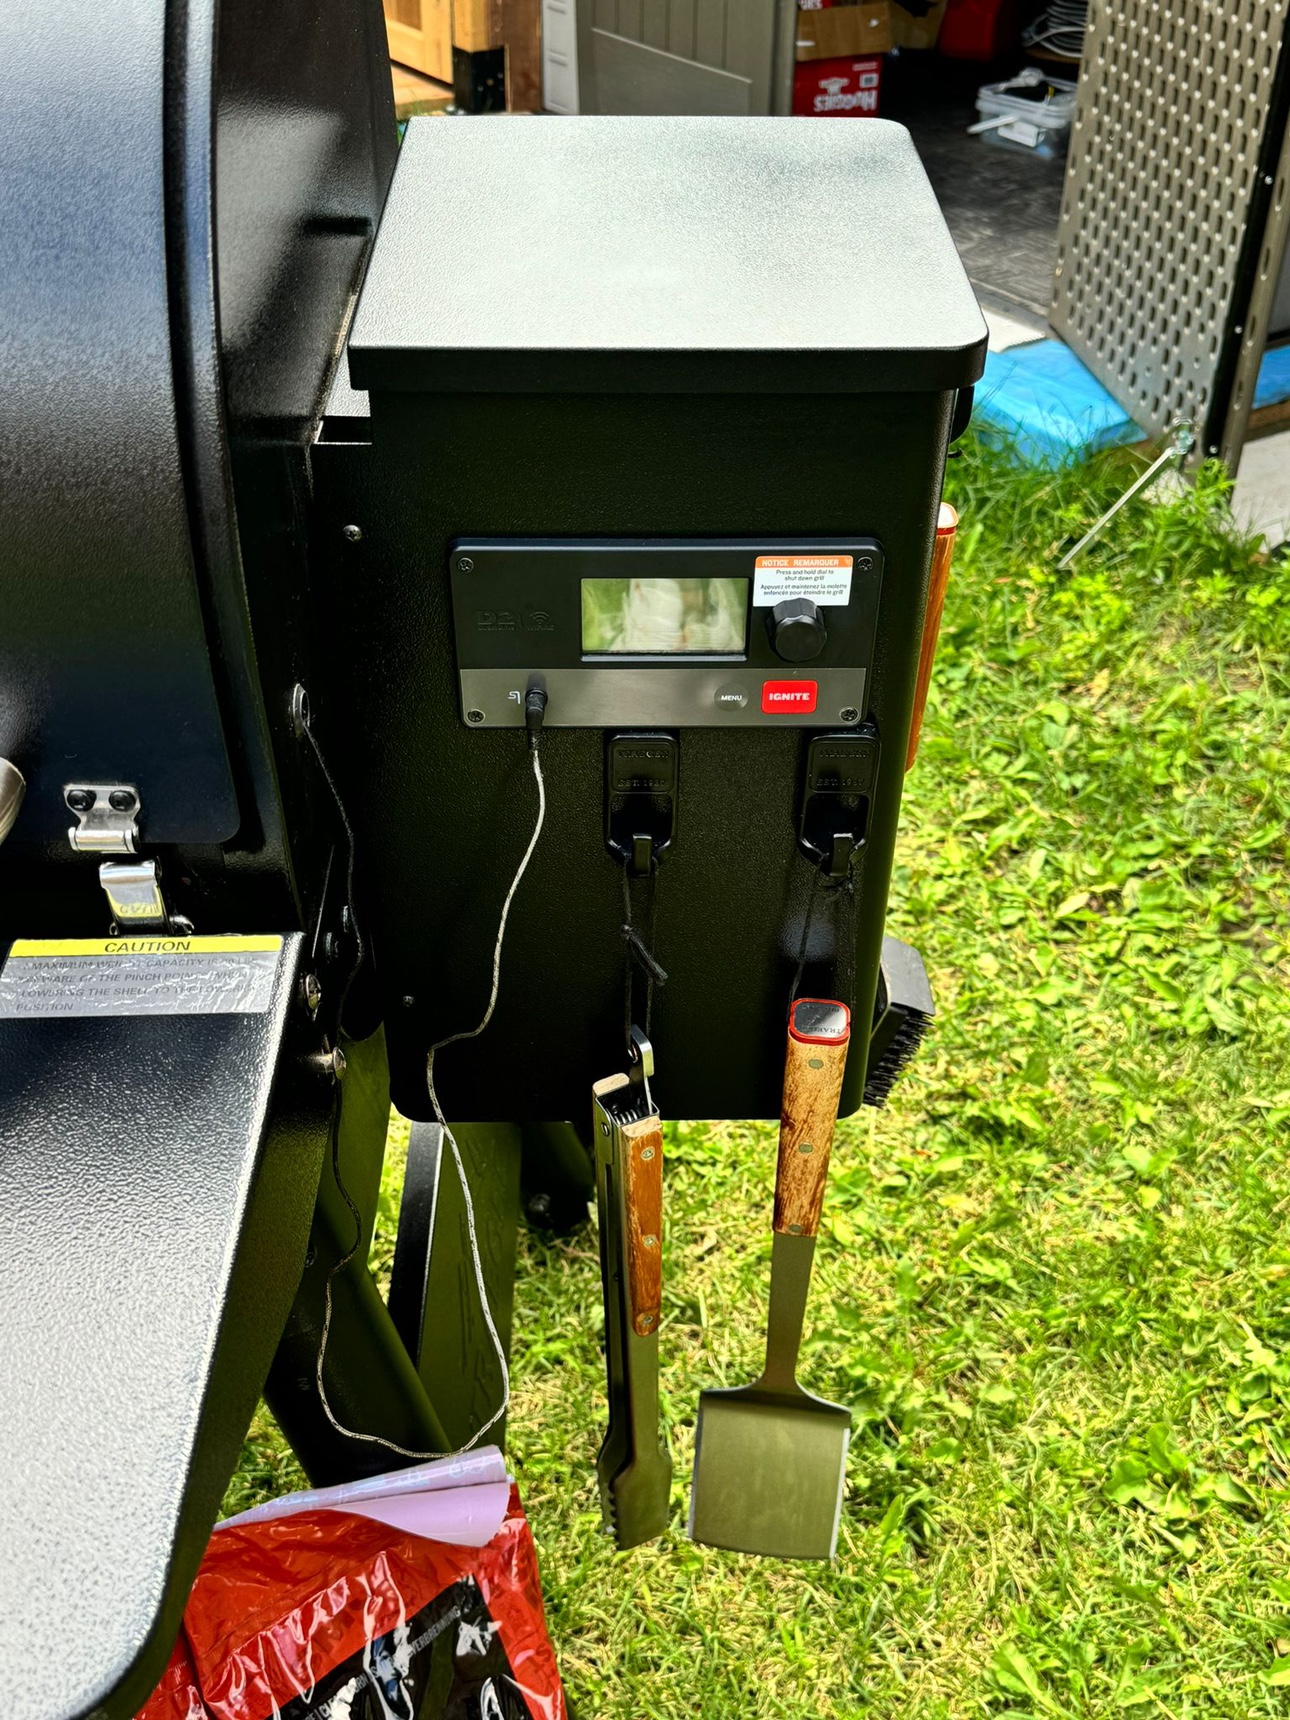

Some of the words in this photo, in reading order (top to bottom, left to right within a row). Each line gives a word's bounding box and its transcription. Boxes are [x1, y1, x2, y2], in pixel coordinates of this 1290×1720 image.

[762, 558, 789, 567] NOTICE
[793, 558, 840, 567] REMARQUER
[720, 694, 743, 702] MENU
[768, 692, 811, 701] IGNITE
[104, 941, 191, 952] CAUTION
[146, 958, 204, 968] CAPACITY
[99, 974, 122, 982] THE
[124, 972, 161, 982] PINCH
[88, 988, 110, 997] THE
[154, 986, 170, 994] TO
